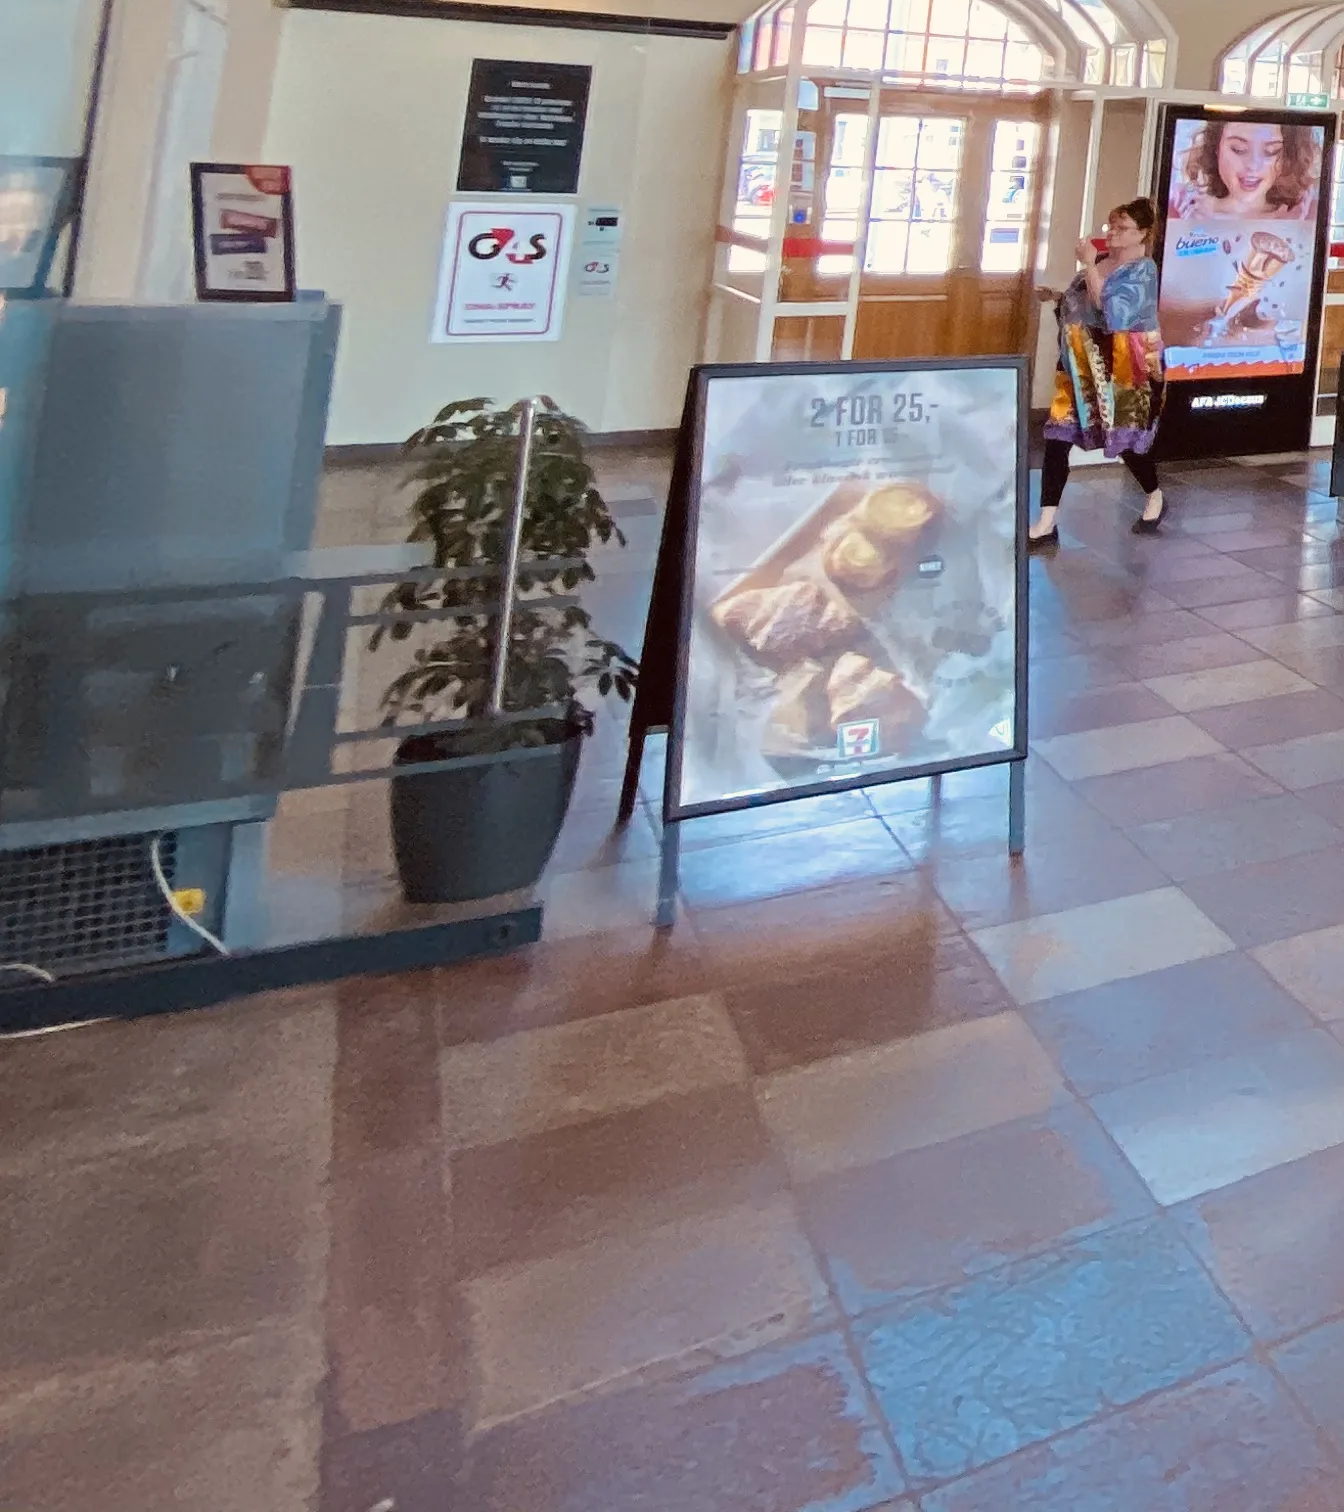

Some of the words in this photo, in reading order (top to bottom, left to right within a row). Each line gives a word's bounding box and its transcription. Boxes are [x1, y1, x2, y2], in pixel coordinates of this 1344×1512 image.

[468, 228, 548, 264] G4S
[1175, 237, 1220, 250] bueno
[810, 397, 826, 428] 2
[835, 394, 884, 427] FOR
[892, 392, 940, 424] 25,-
[847, 428, 877, 446] FOR
